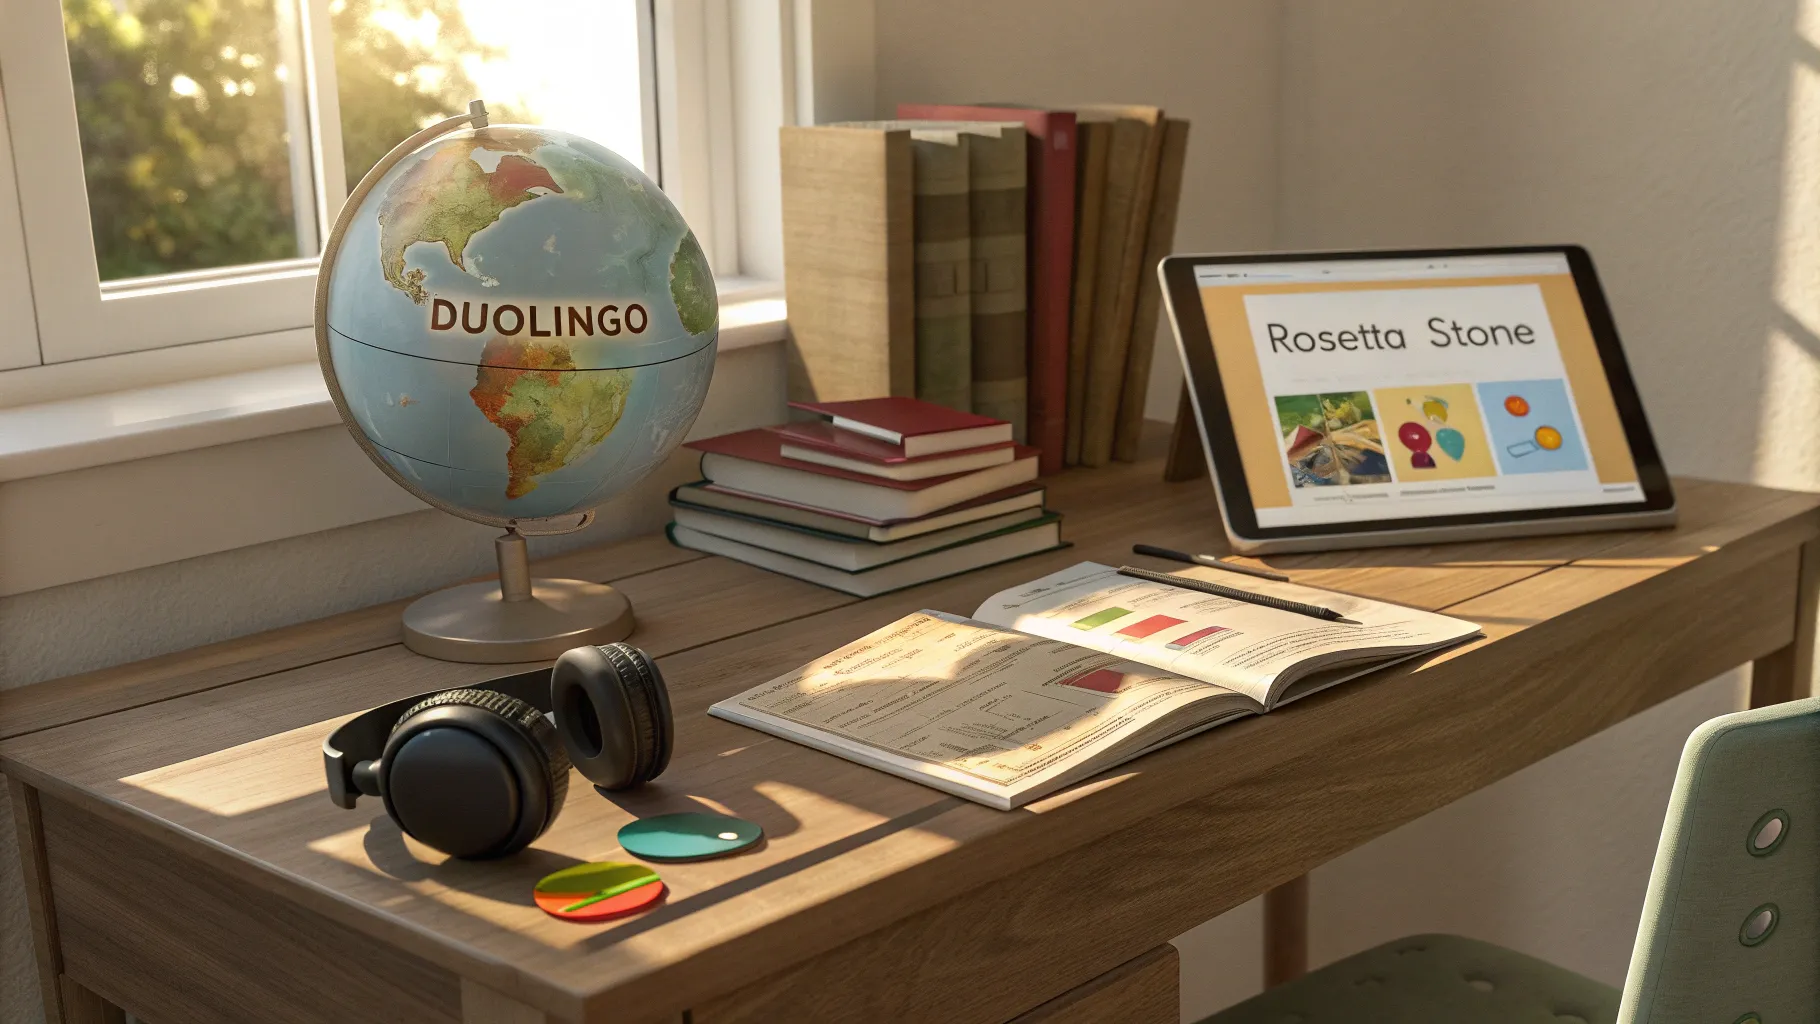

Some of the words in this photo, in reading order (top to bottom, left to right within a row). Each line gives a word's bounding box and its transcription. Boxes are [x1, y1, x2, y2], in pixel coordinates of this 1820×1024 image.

[431, 298, 648, 337] DUOLINGO
[1267, 323, 1406, 353] Rosetta
[1427, 317, 1536, 348] Stone
